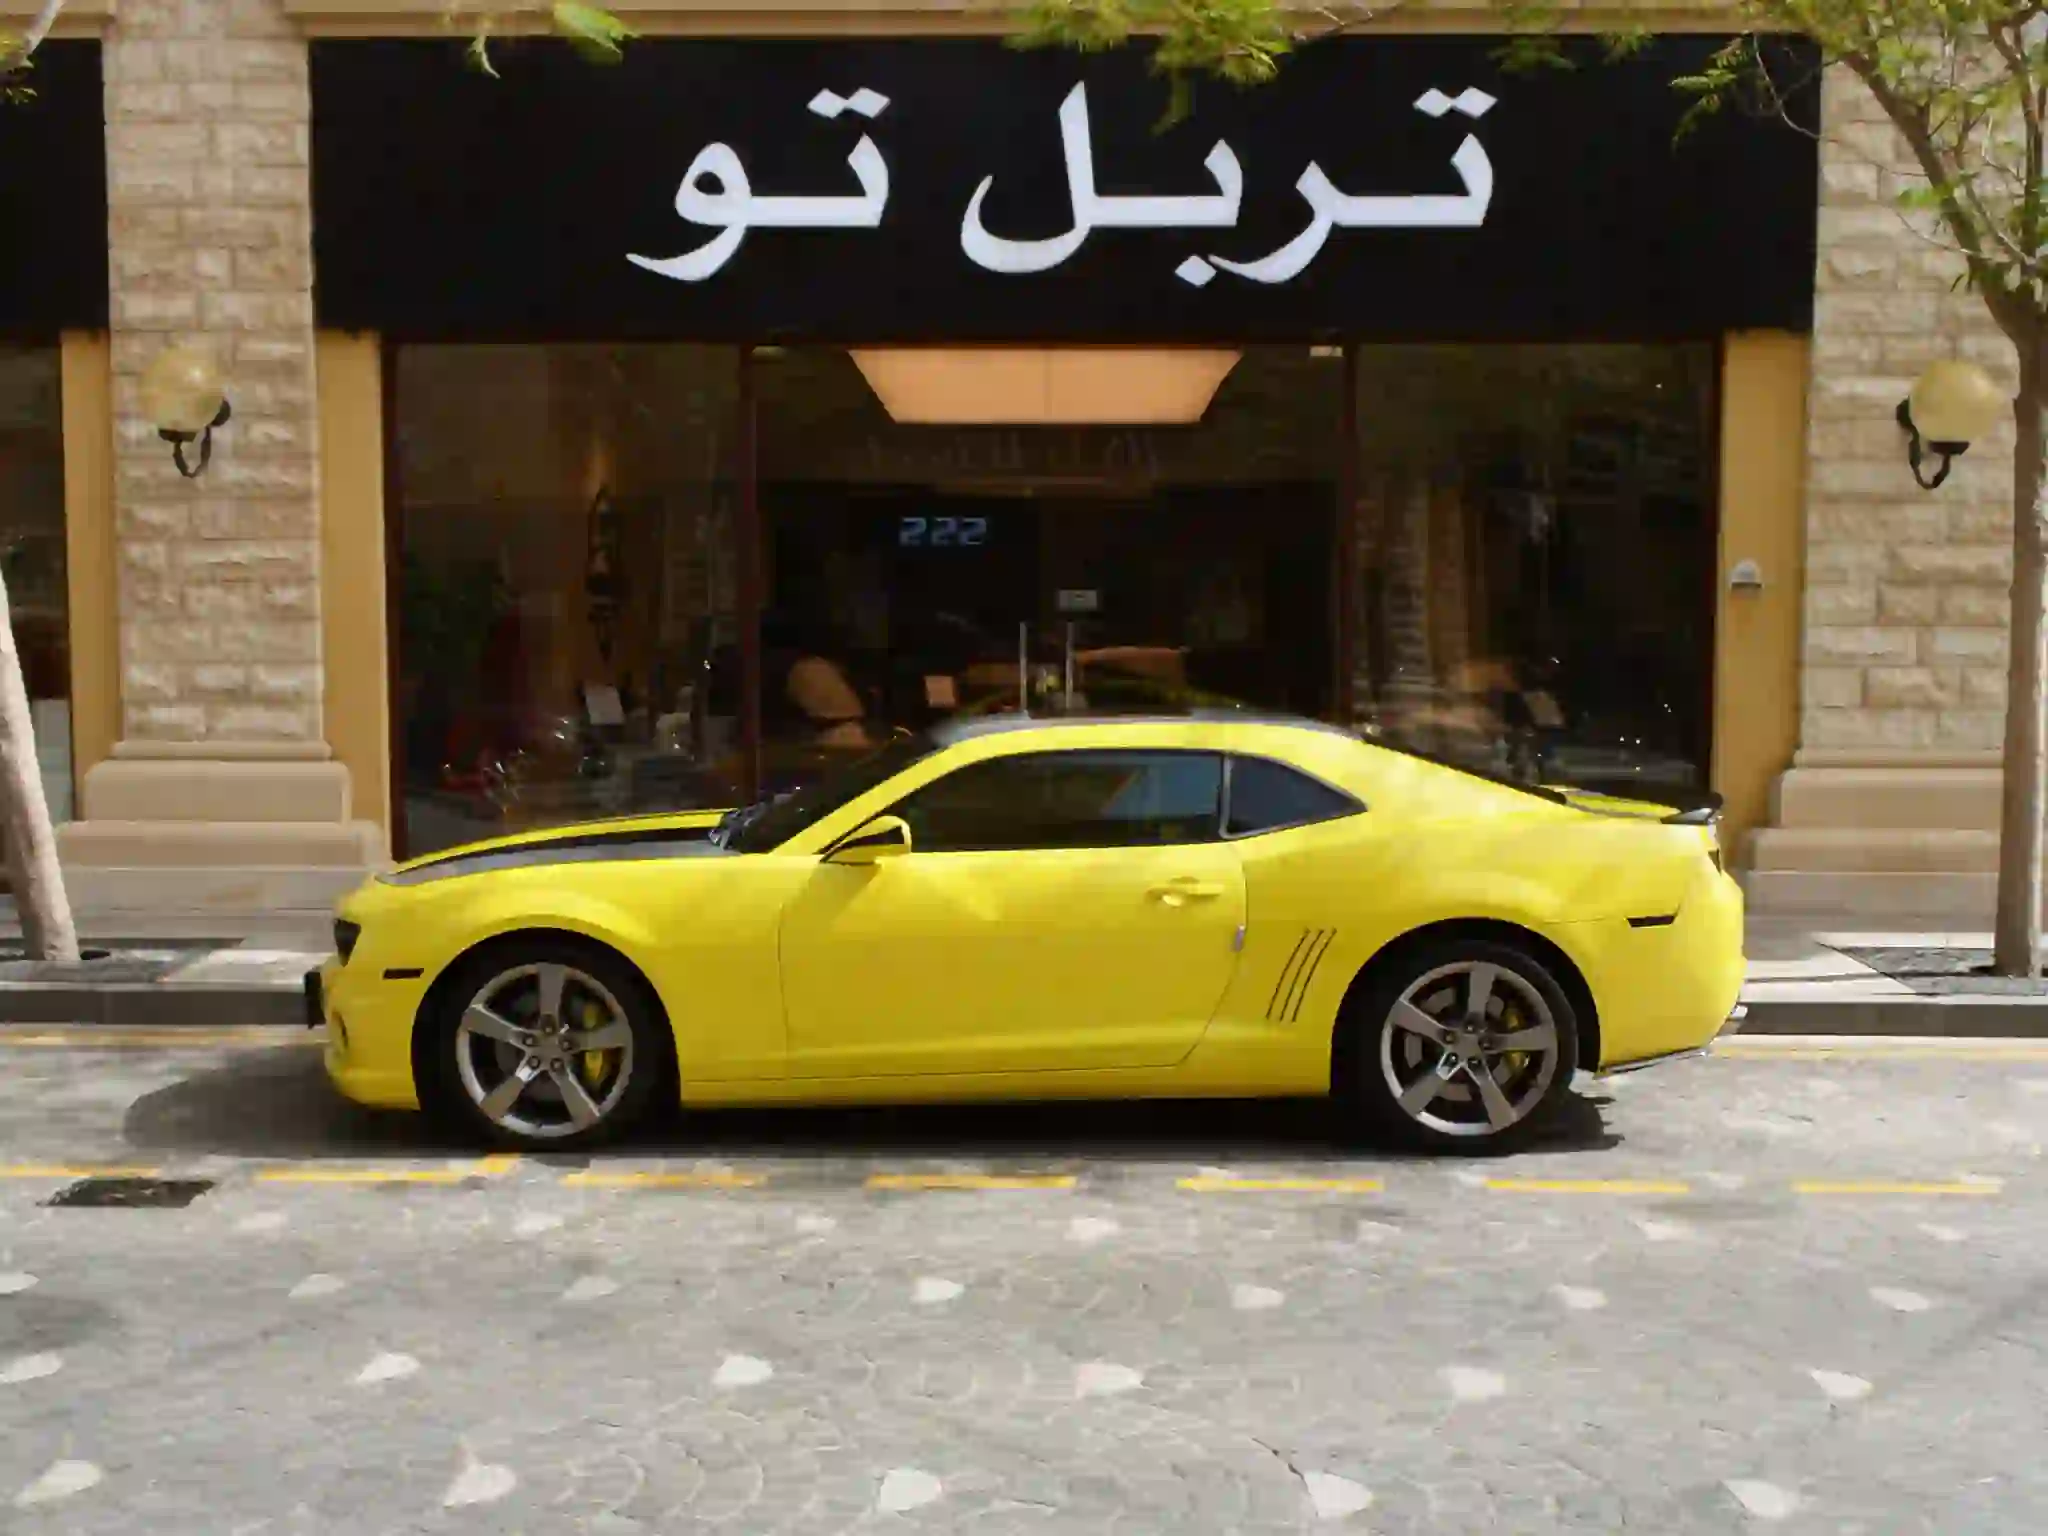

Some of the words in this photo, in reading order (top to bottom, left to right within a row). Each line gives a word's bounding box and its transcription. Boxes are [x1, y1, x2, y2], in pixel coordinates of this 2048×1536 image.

[626, 87, 890, 281] تو
[961, 82, 1497, 286] تربل
[899, 516, 988, 546] 222
